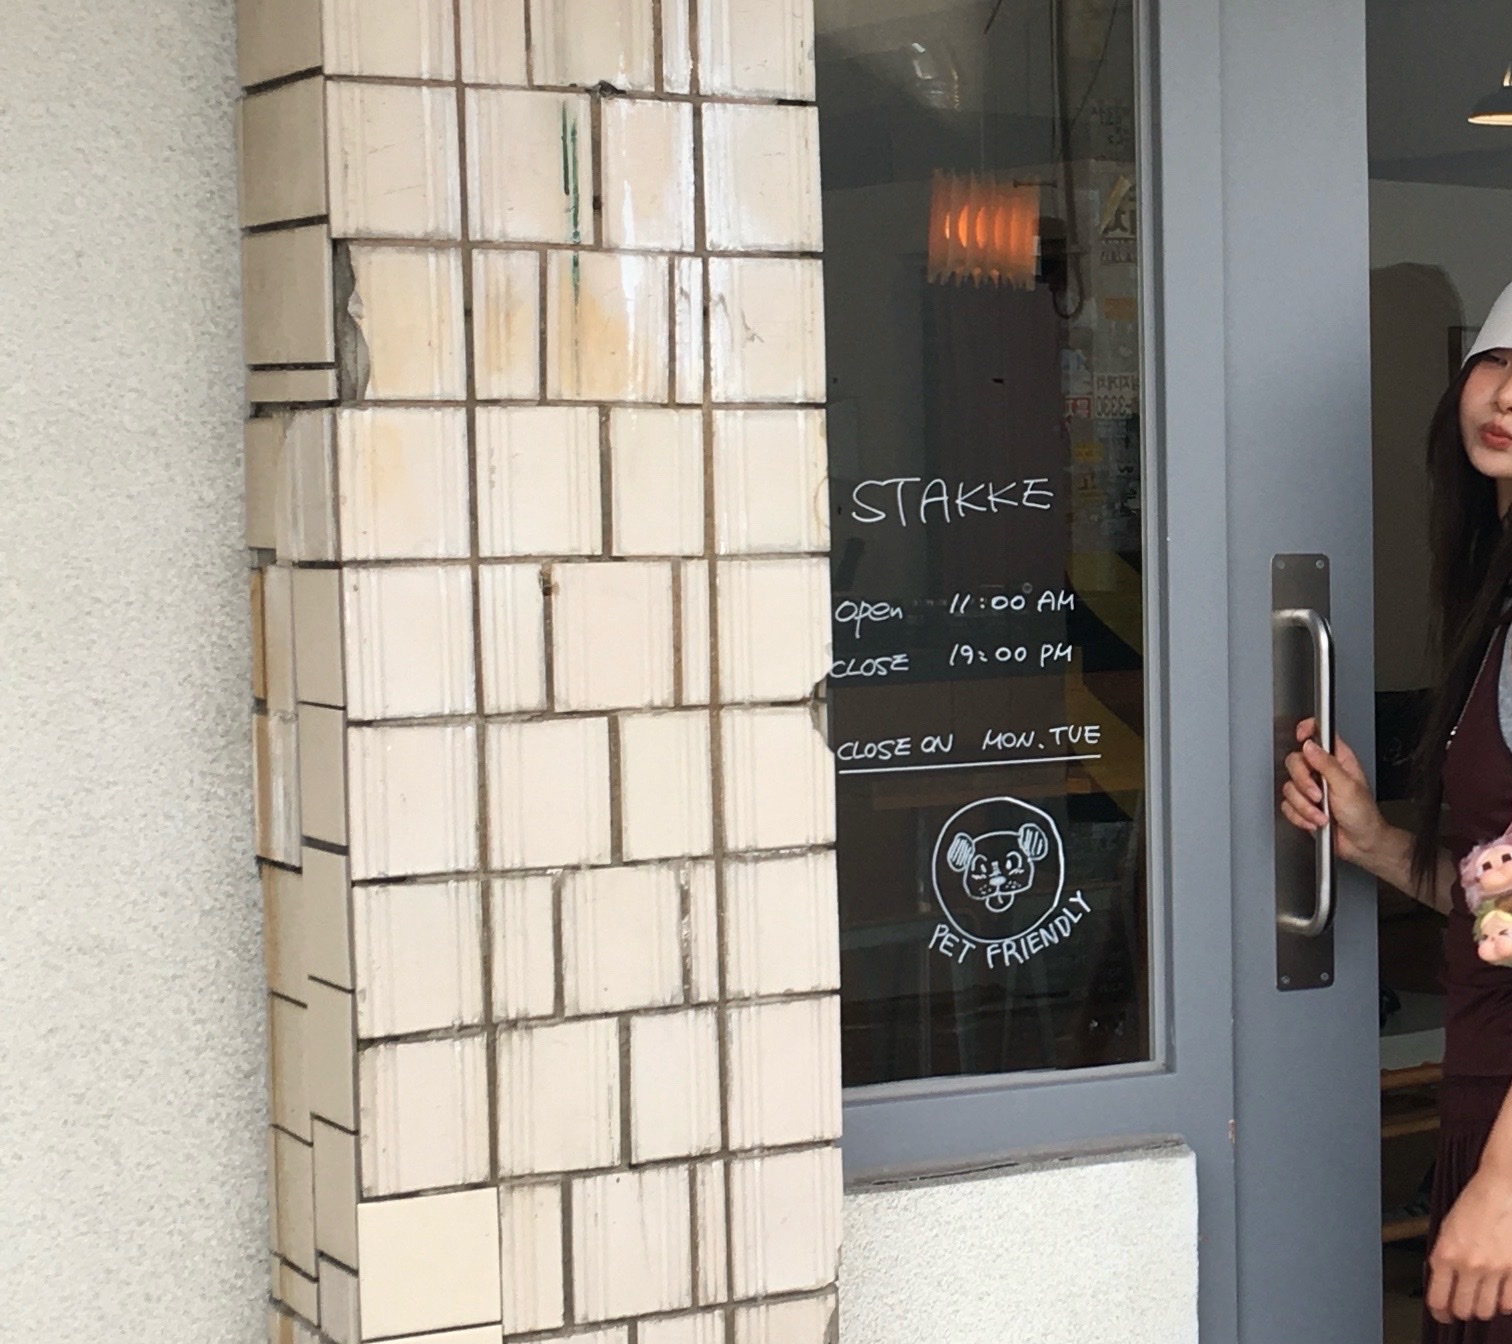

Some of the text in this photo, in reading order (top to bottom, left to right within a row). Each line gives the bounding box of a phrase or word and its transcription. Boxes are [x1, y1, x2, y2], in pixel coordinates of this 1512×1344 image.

[851, 477, 1054, 527] STAKKE
[949, 592, 1026, 614] 11:00
[1037, 589, 1075, 613] AM
[829, 642, 1073, 679] CLOSE 19:00 PM
[836, 737, 911, 761] CLOSE
[920, 733, 954, 753] ON
[1048, 724, 1101, 746] TUE
[928, 890, 1091, 969] PET FRIENDLY
